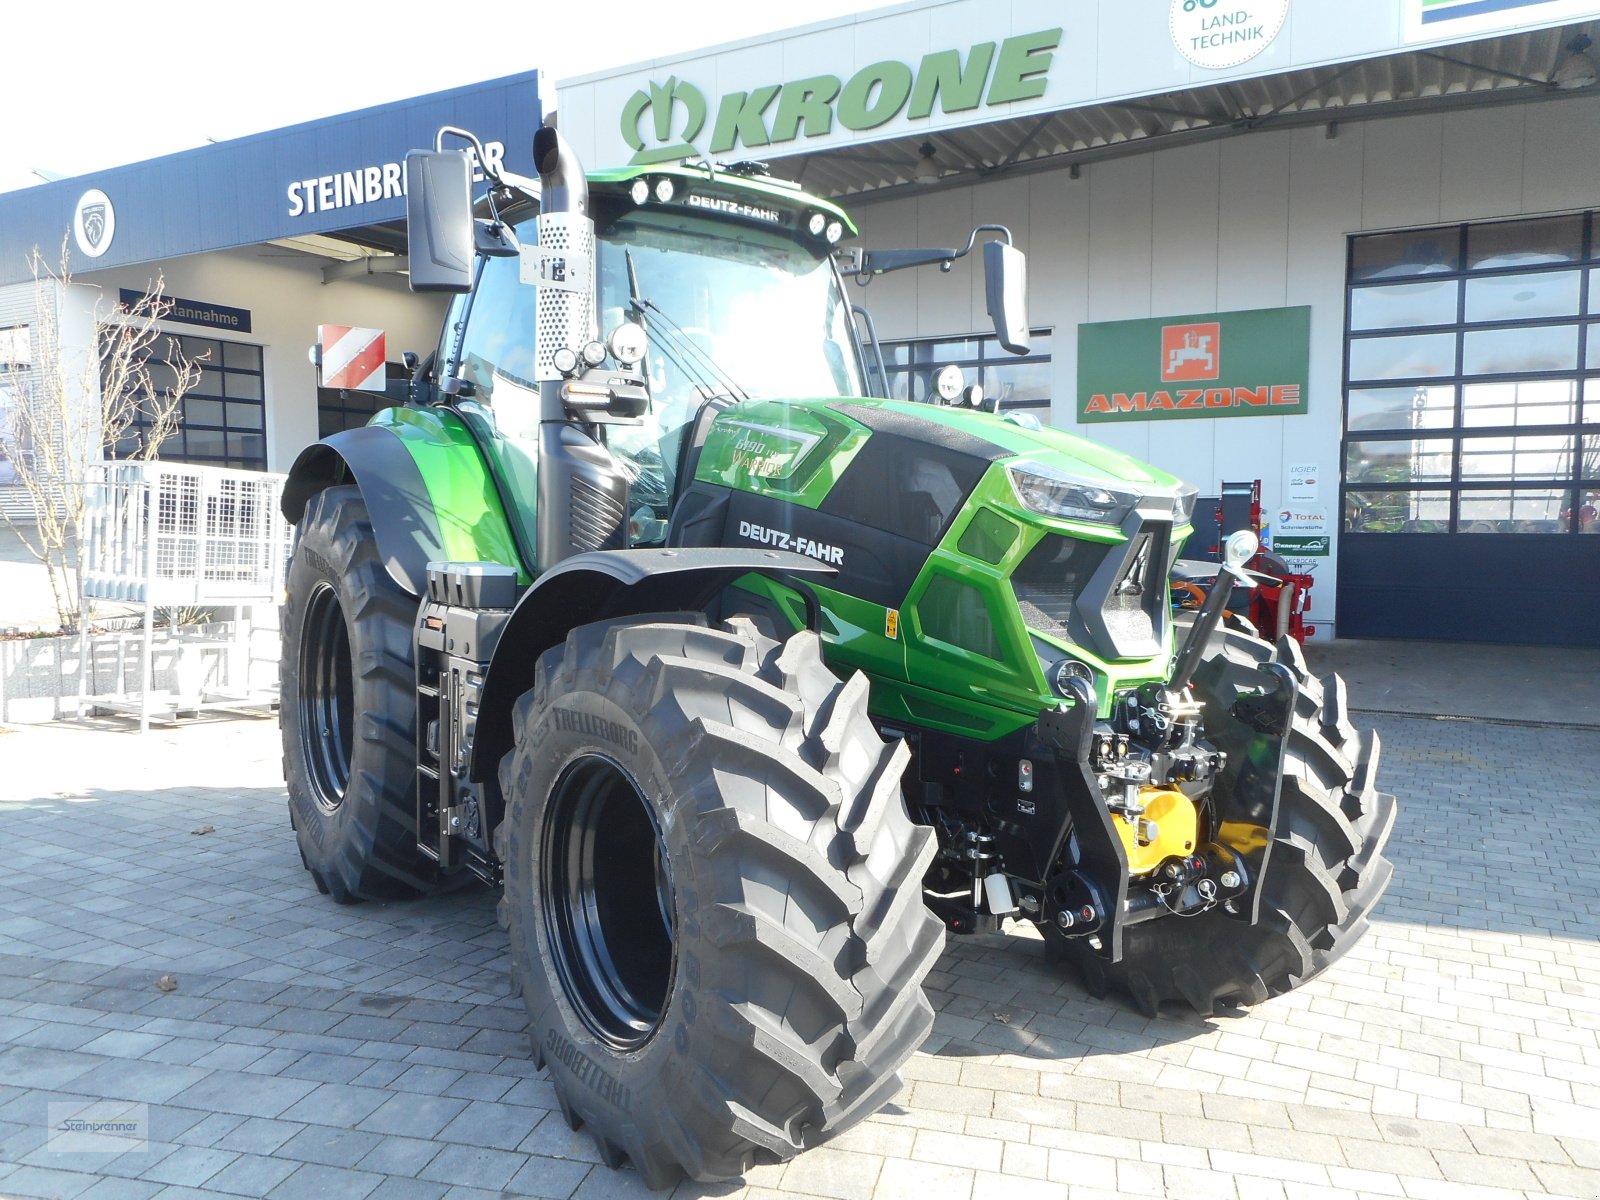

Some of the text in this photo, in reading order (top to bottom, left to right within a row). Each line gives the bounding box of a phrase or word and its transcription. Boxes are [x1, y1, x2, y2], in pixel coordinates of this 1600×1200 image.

[1201, 10, 1253, 31] LAND-
[1190, 25, 1264, 50] TECHNIK
[709, 27, 1064, 154] KRONE
[287, 141, 505, 217] STEINBRER
[689, 194, 780, 221] DEUTZ-FAHR
[1084, 384, 1300, 413] AMAZONE
[1294, 513, 1326, 521] TOTAL
[739, 520, 845, 566] DEUTZ-FAHR
[552, 706, 638, 755] TRELLEBORG
